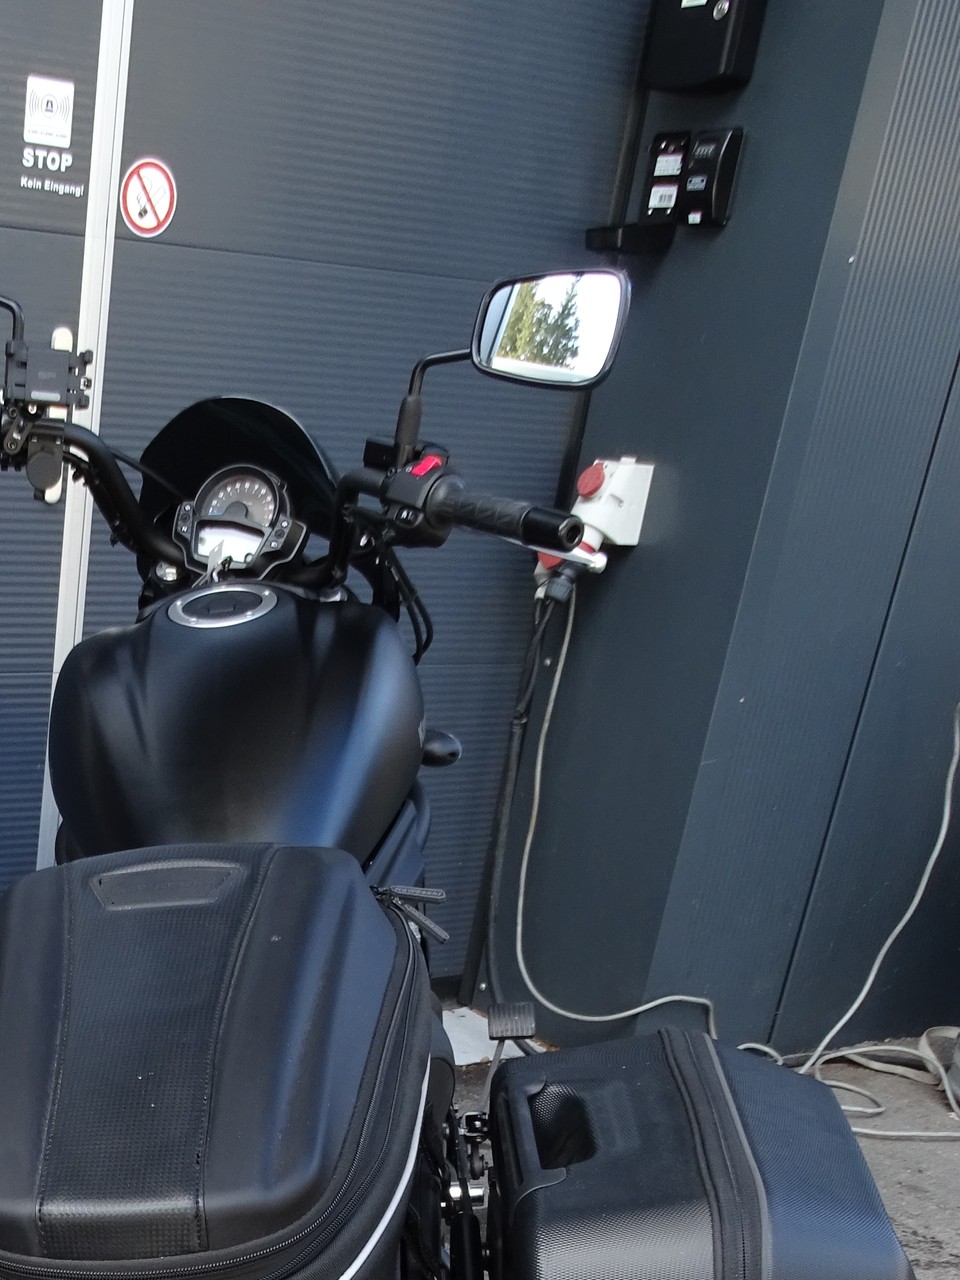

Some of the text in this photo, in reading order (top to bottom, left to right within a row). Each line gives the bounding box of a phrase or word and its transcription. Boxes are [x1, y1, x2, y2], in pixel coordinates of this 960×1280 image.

[22, 147, 73, 172] STOP
[20, 175, 84, 197] Kein Eingang!
